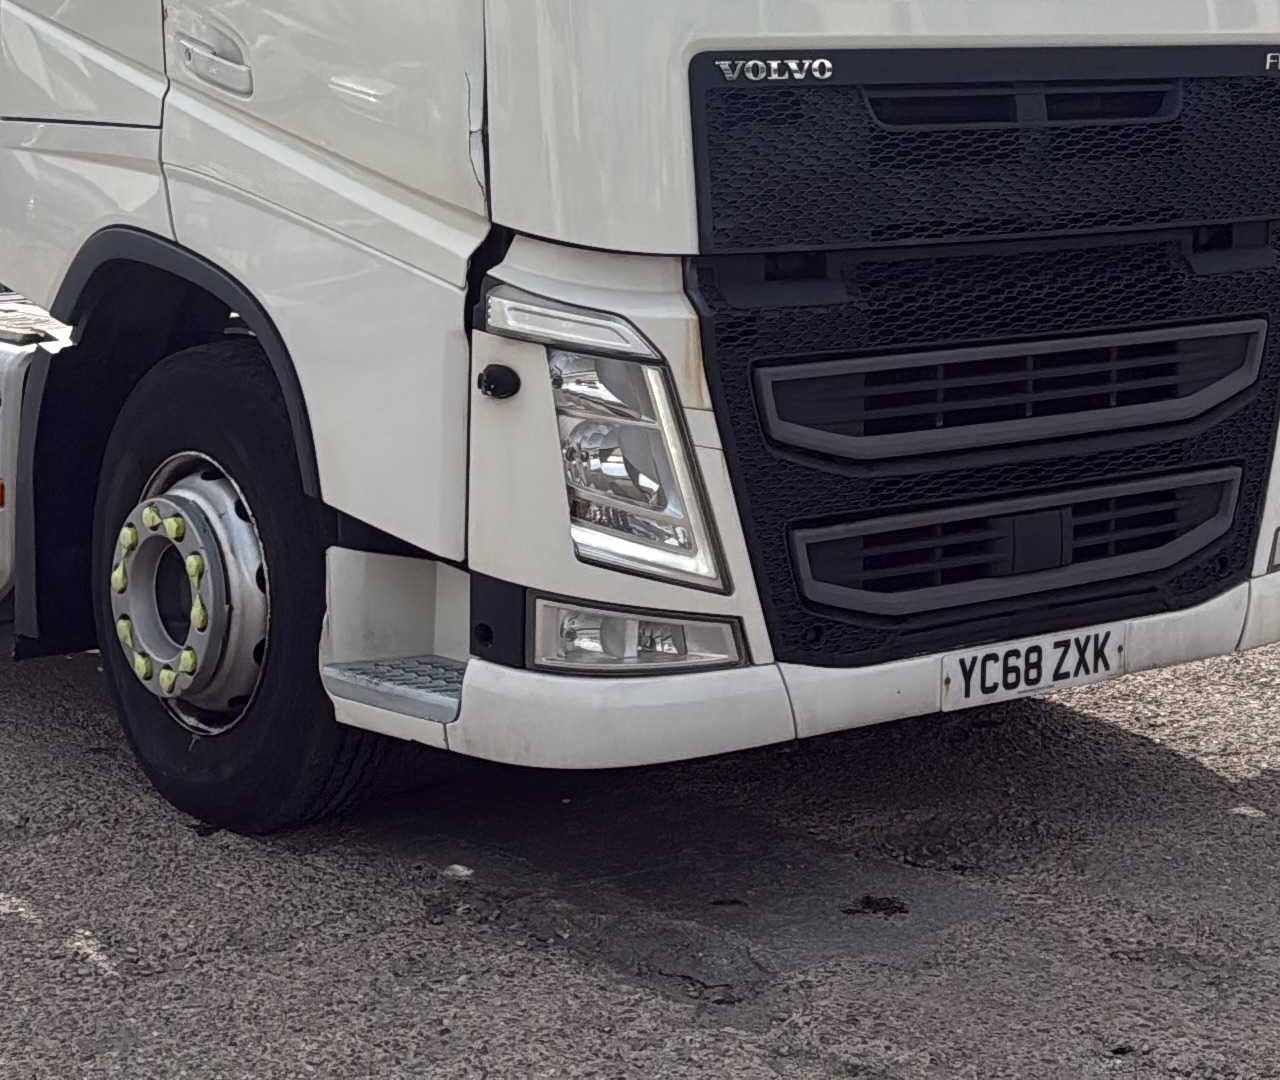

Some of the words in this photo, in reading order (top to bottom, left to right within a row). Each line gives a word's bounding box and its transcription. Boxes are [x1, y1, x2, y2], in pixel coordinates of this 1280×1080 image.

[715, 59, 833, 81] VOLVO
[959, 644, 1043, 699] YC68
[1052, 630, 1112, 682] ZXK
